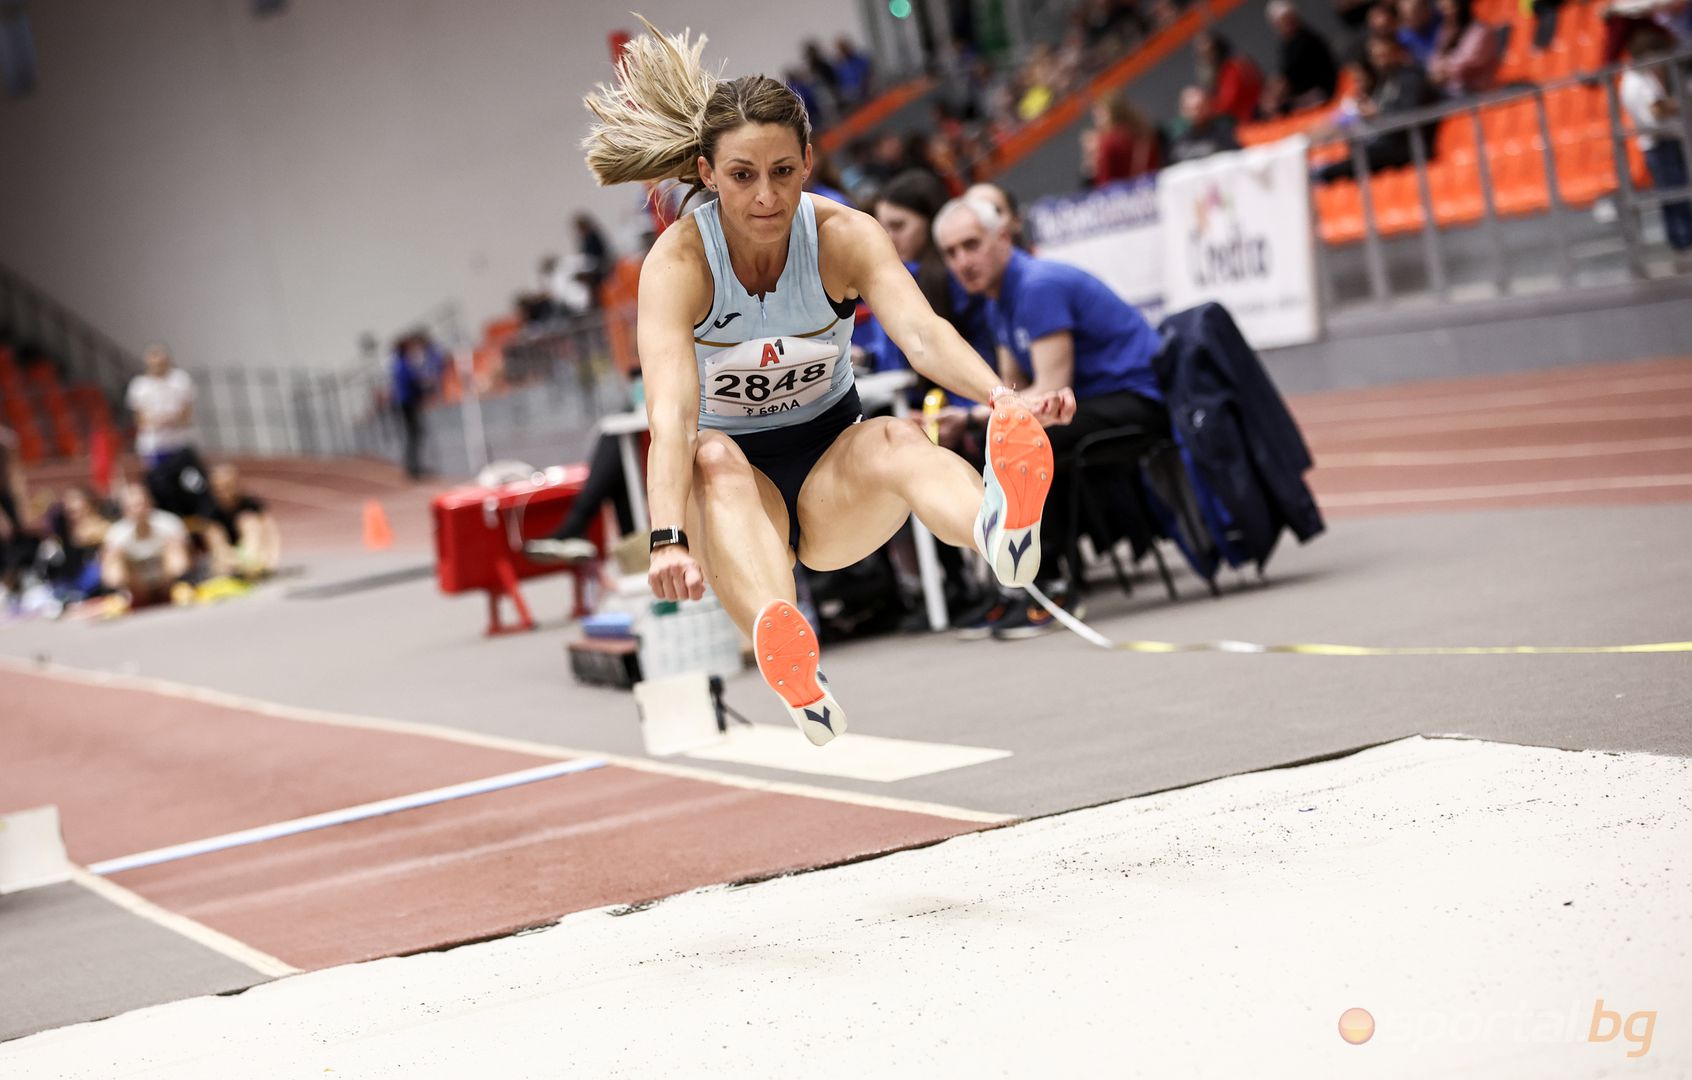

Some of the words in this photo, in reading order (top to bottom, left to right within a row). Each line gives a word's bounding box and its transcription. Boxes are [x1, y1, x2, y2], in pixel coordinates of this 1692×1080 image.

[760, 339, 784, 367] A1
[714, 363, 826, 401] 2848
[760, 399, 800, 414] БФЛА
